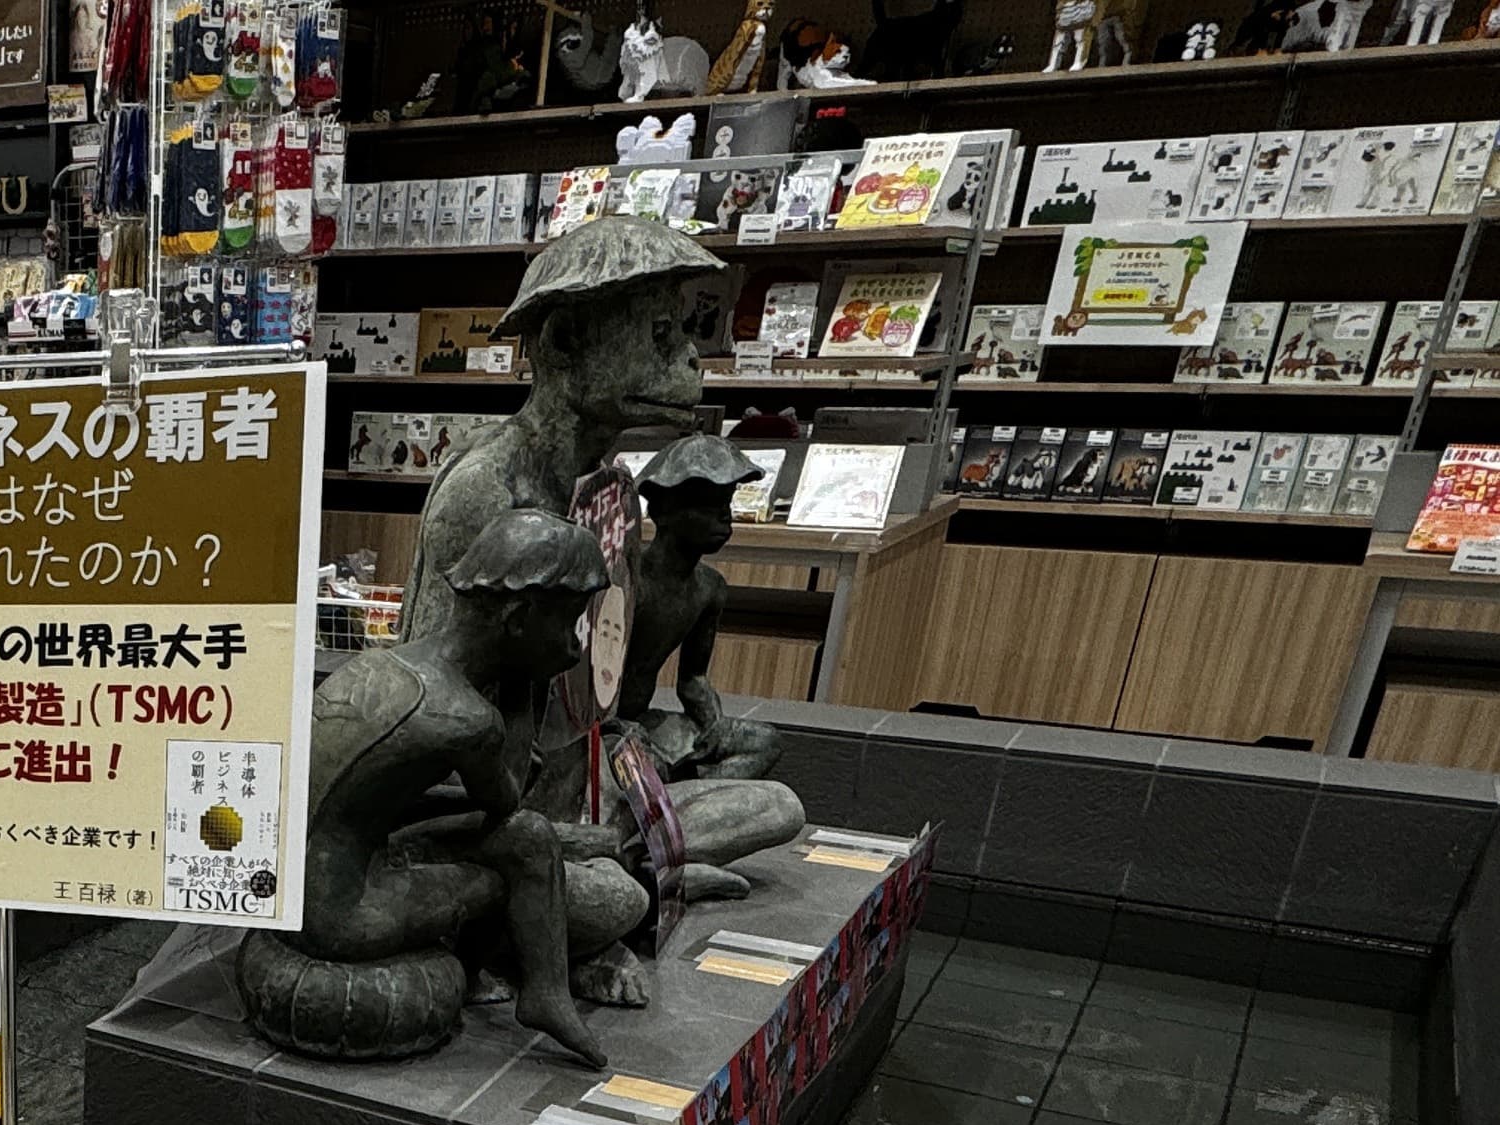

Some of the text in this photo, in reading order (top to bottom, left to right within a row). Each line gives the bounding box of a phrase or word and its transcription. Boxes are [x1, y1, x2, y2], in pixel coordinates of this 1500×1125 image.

[190, 749, 206, 796] の覇者
[216, 750, 232, 806] ビジネス
[53, 881, 118, 904] 王 百禄
[179, 887, 260, 915] TSMC
